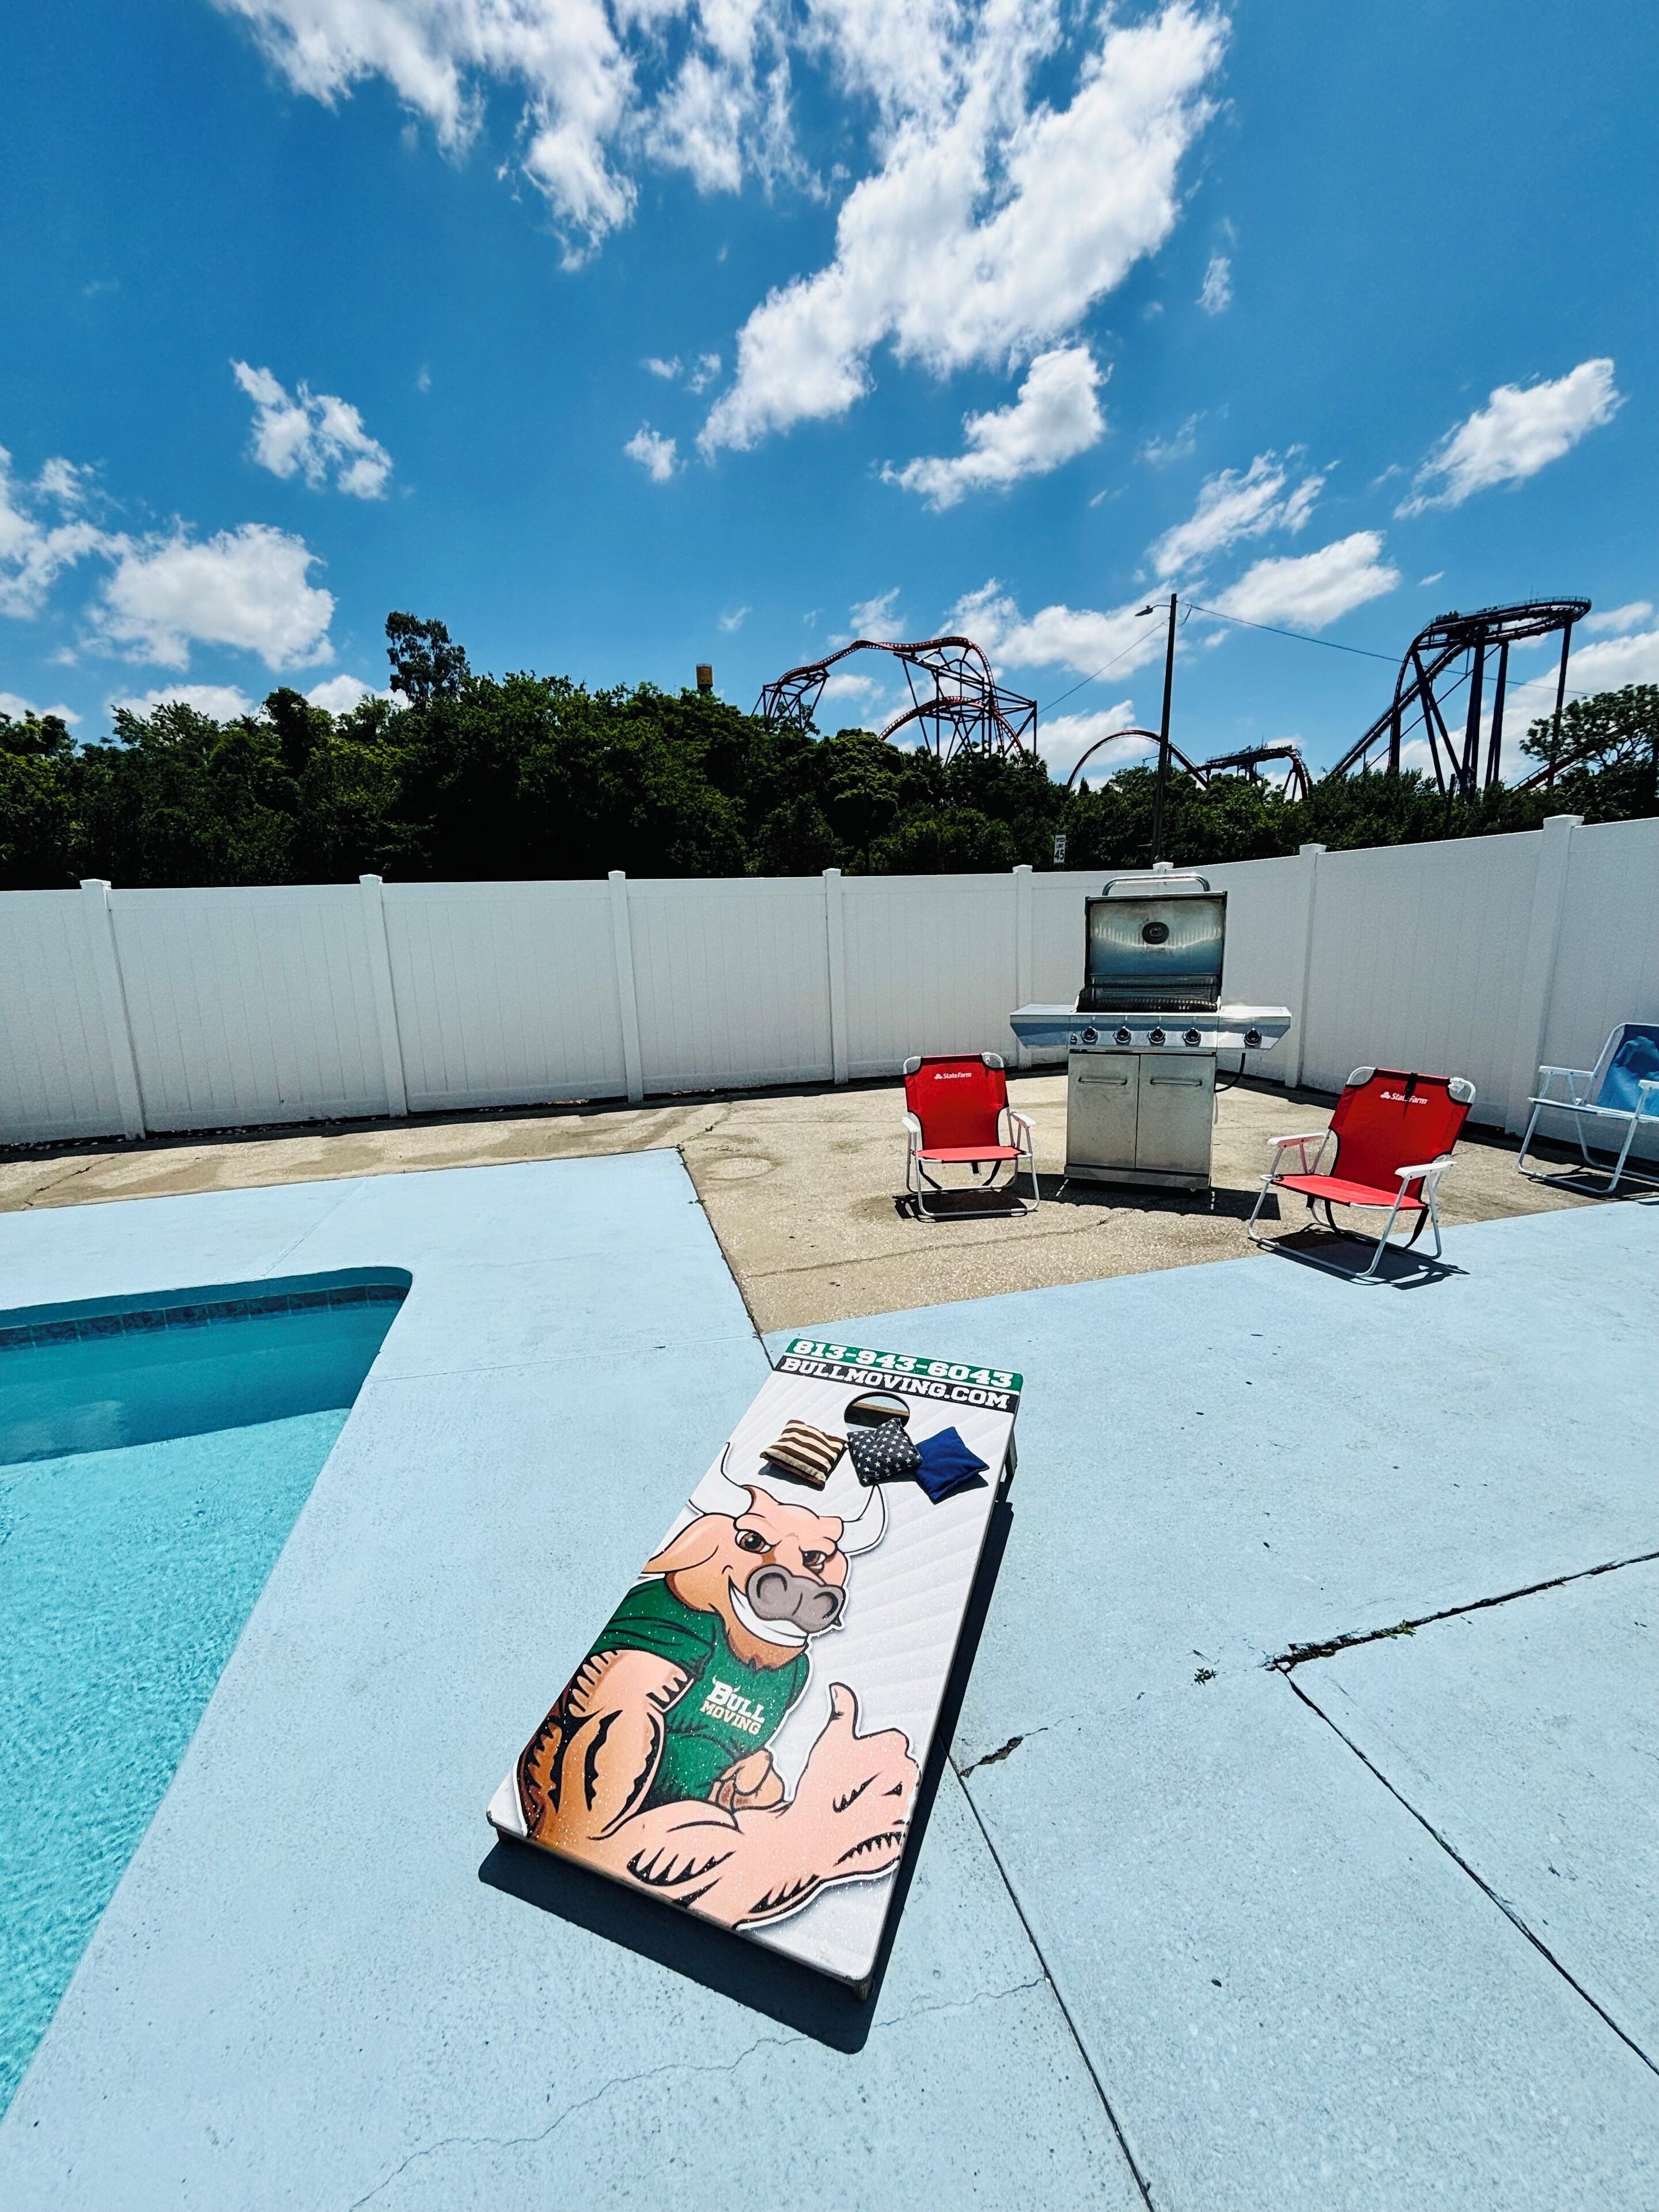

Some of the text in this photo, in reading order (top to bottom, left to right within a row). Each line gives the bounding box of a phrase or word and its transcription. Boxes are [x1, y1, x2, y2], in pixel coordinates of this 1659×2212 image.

[1055, 849, 1065, 860] 45
[781, 1357, 1011, 1410] BULLMOVING.COM
[793, 1340, 1014, 1388] 813-943-6043
[699, 1700, 762, 1736] MOVING
[706, 1677, 766, 1724] BULL
